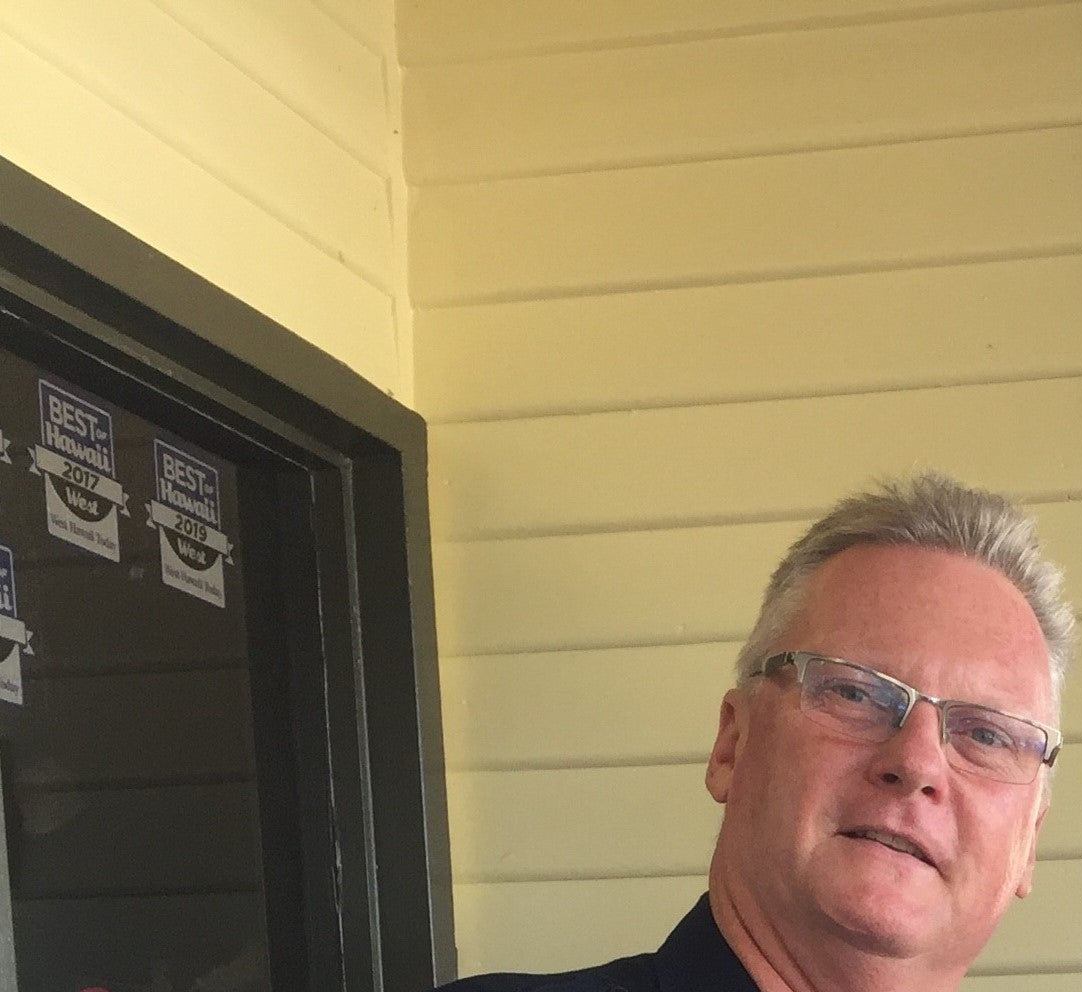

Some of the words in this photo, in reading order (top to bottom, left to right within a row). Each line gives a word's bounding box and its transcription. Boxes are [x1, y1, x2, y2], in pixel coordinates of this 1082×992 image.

[48, 394, 98, 441] BEST
[45, 421, 112, 472] Hawaii
[62, 461, 100, 490] 2017
[163, 453, 206, 496] BEST
[66, 486, 99, 516] West
[160, 478, 218, 524] Hawaii
[175, 515, 208, 542] 2019
[177, 538, 206, 565] West
